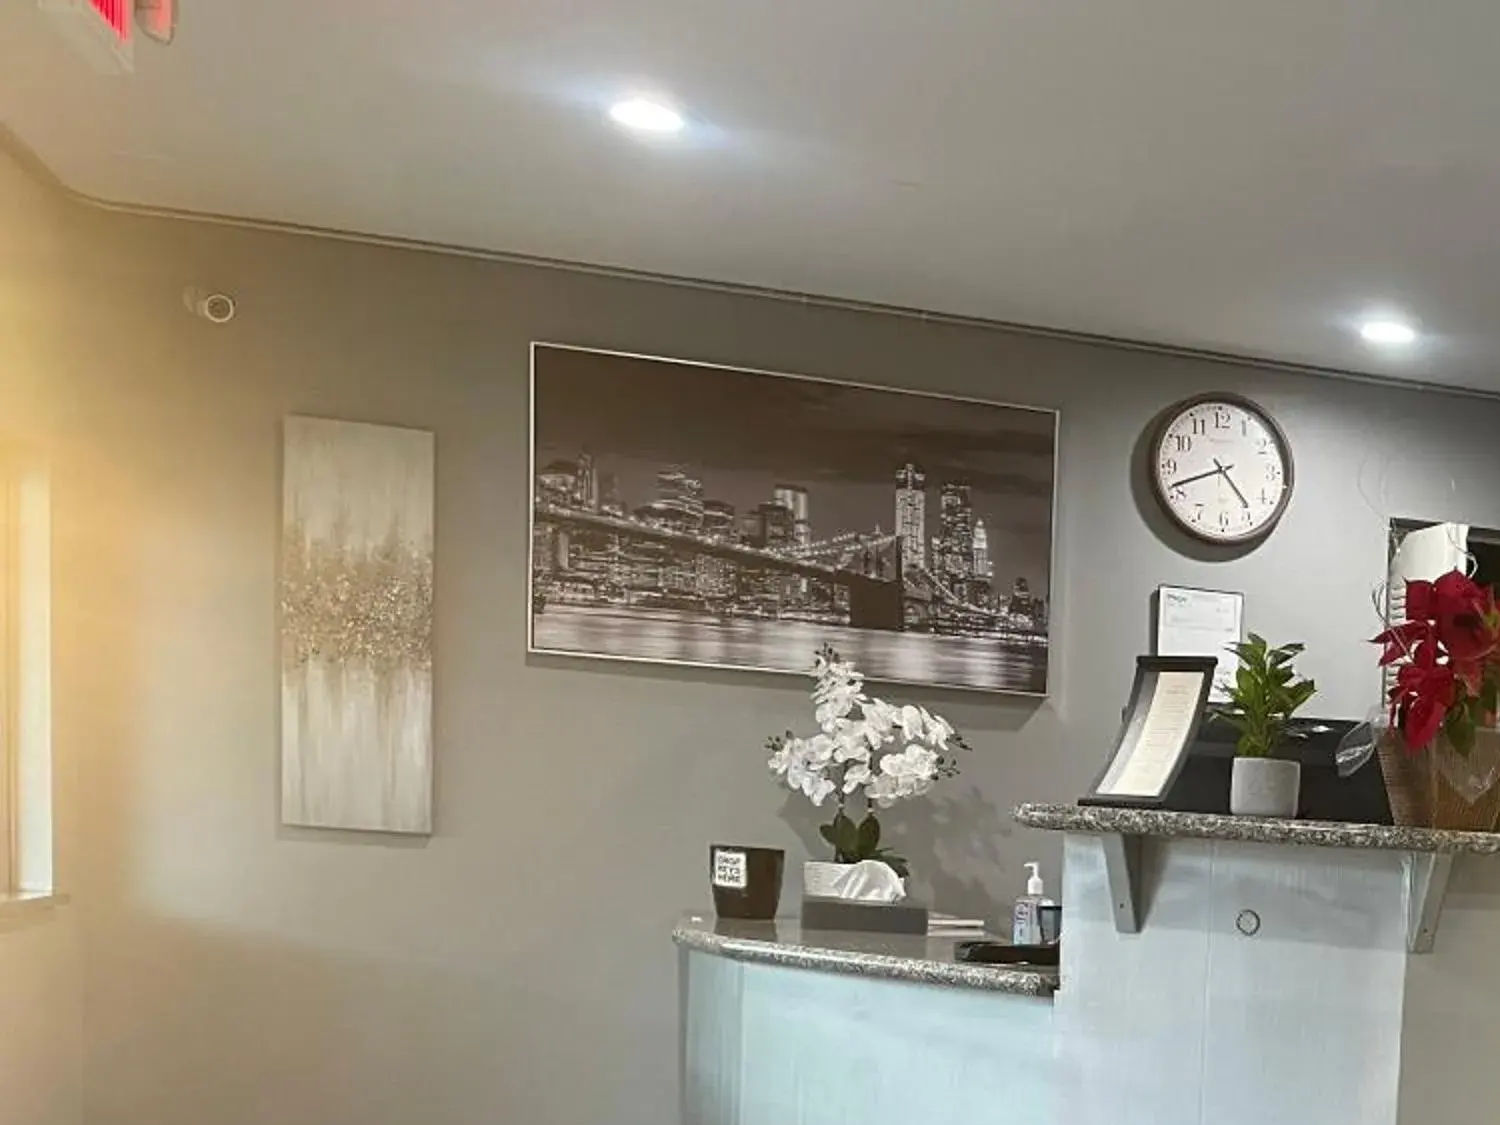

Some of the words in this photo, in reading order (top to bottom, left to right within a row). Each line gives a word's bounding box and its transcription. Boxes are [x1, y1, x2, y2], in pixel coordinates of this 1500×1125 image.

[1192, 418, 1205, 436] 11
[1214, 411, 1231, 429] 12
[1174, 434, 1192, 452] 10
[1255, 438, 1268, 455] 2
[1165, 458, 1178, 476] 9
[1218, 510, 1230, 527] 6
